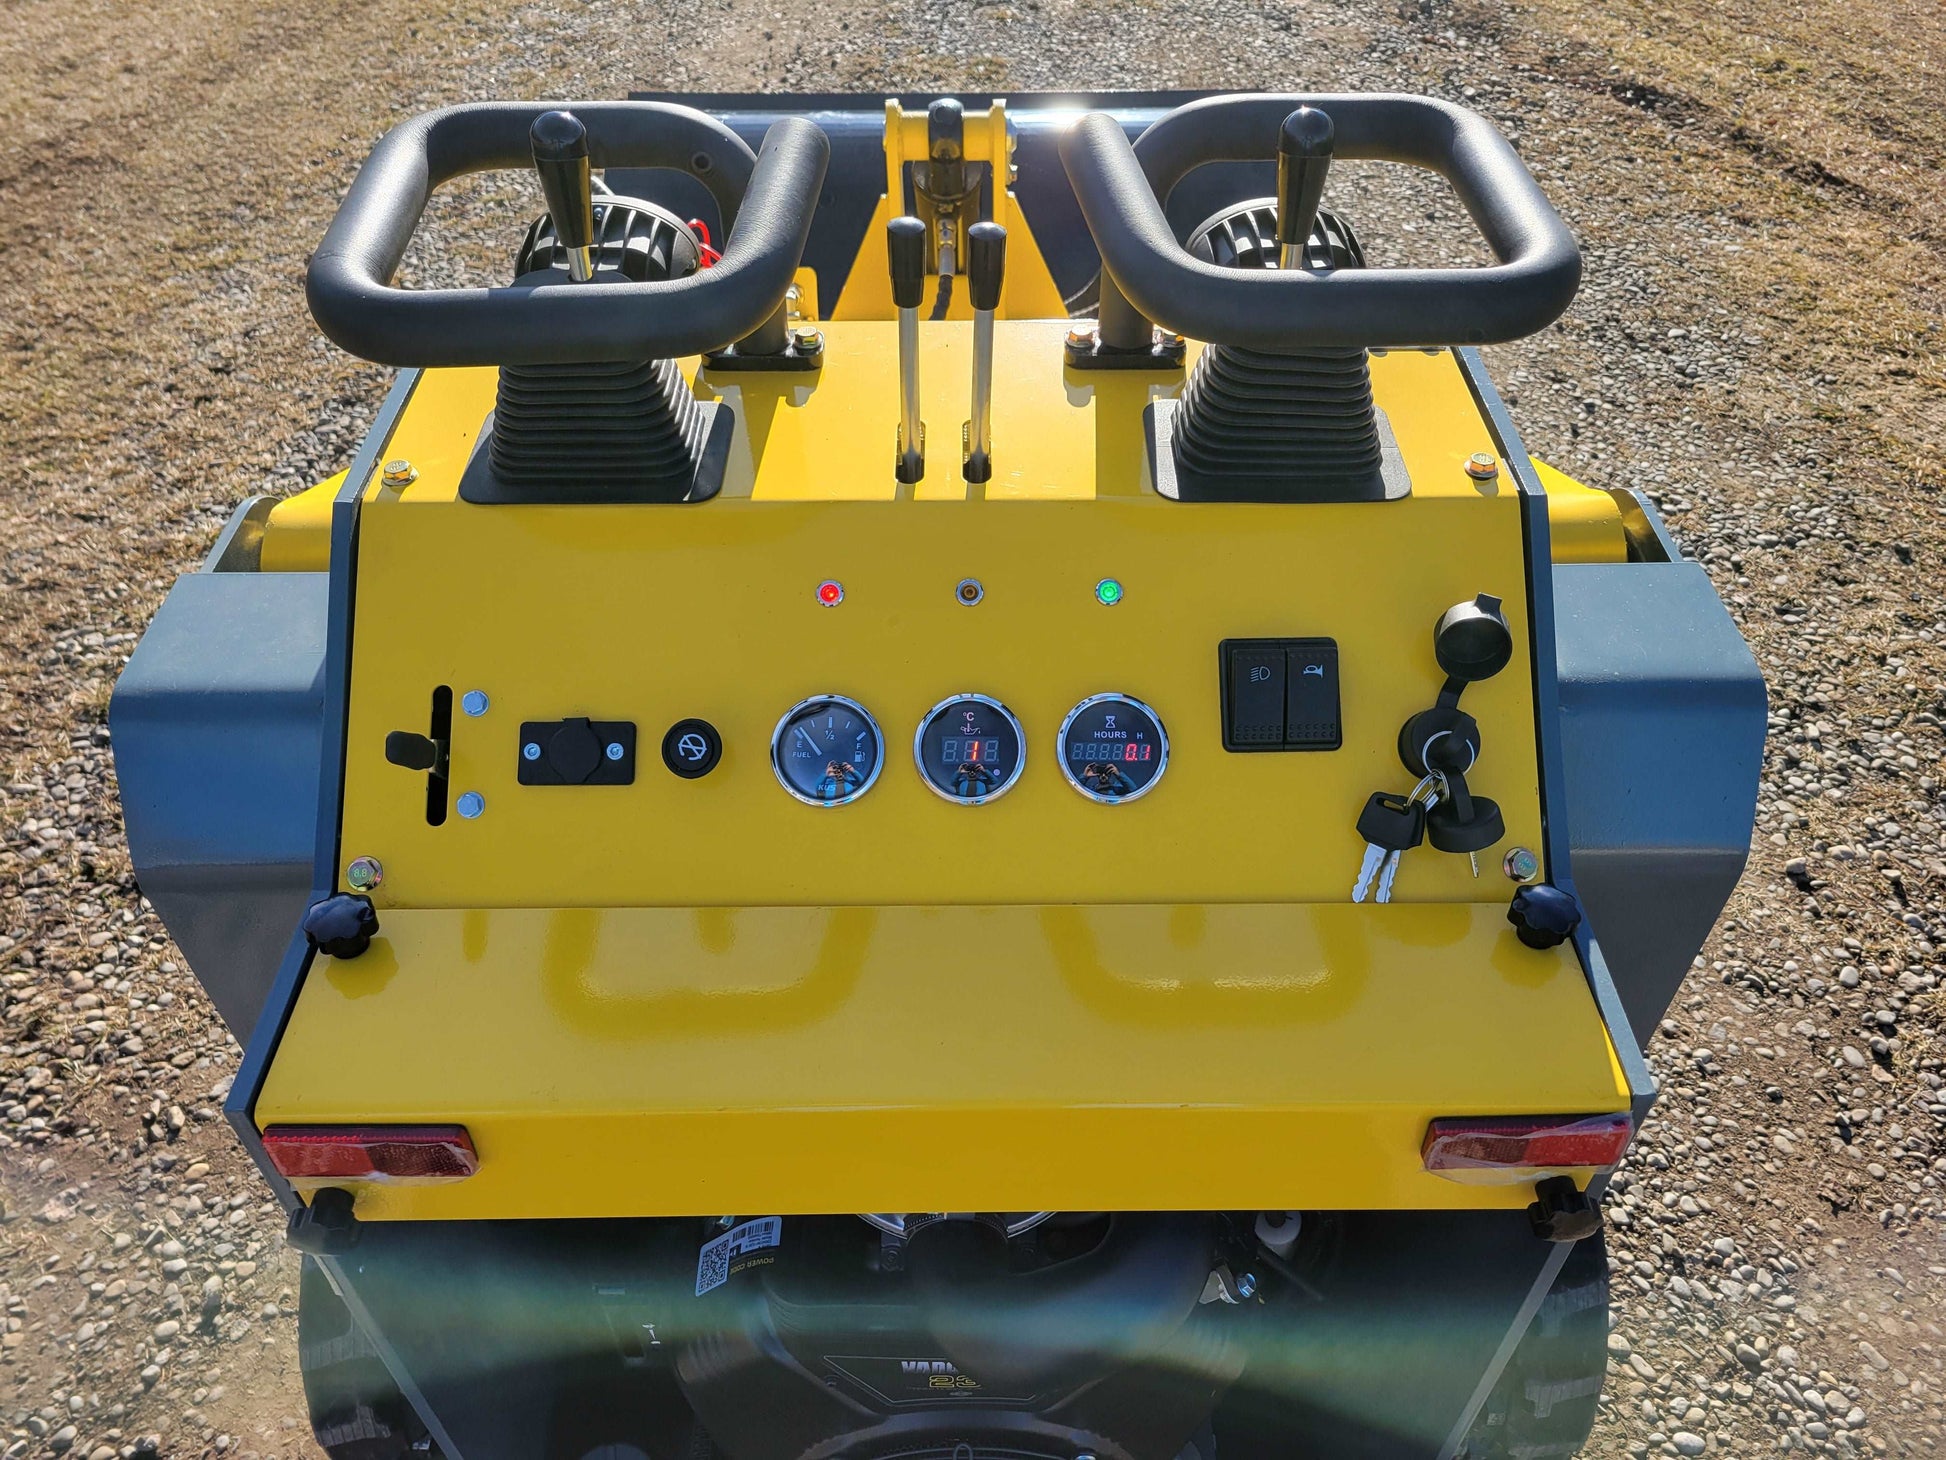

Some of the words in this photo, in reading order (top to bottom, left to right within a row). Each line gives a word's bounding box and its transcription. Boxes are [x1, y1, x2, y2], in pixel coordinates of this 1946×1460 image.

[962, 711, 975, 721] °C
[1094, 731, 1127, 739] HOURS
[796, 740, 802, 748] E
[972, 740, 978, 761] 1
[1125, 743, 1151, 761] 0.1
[747, 1257, 774, 1267] POWER
[928, 1375, 981, 1388] 23
